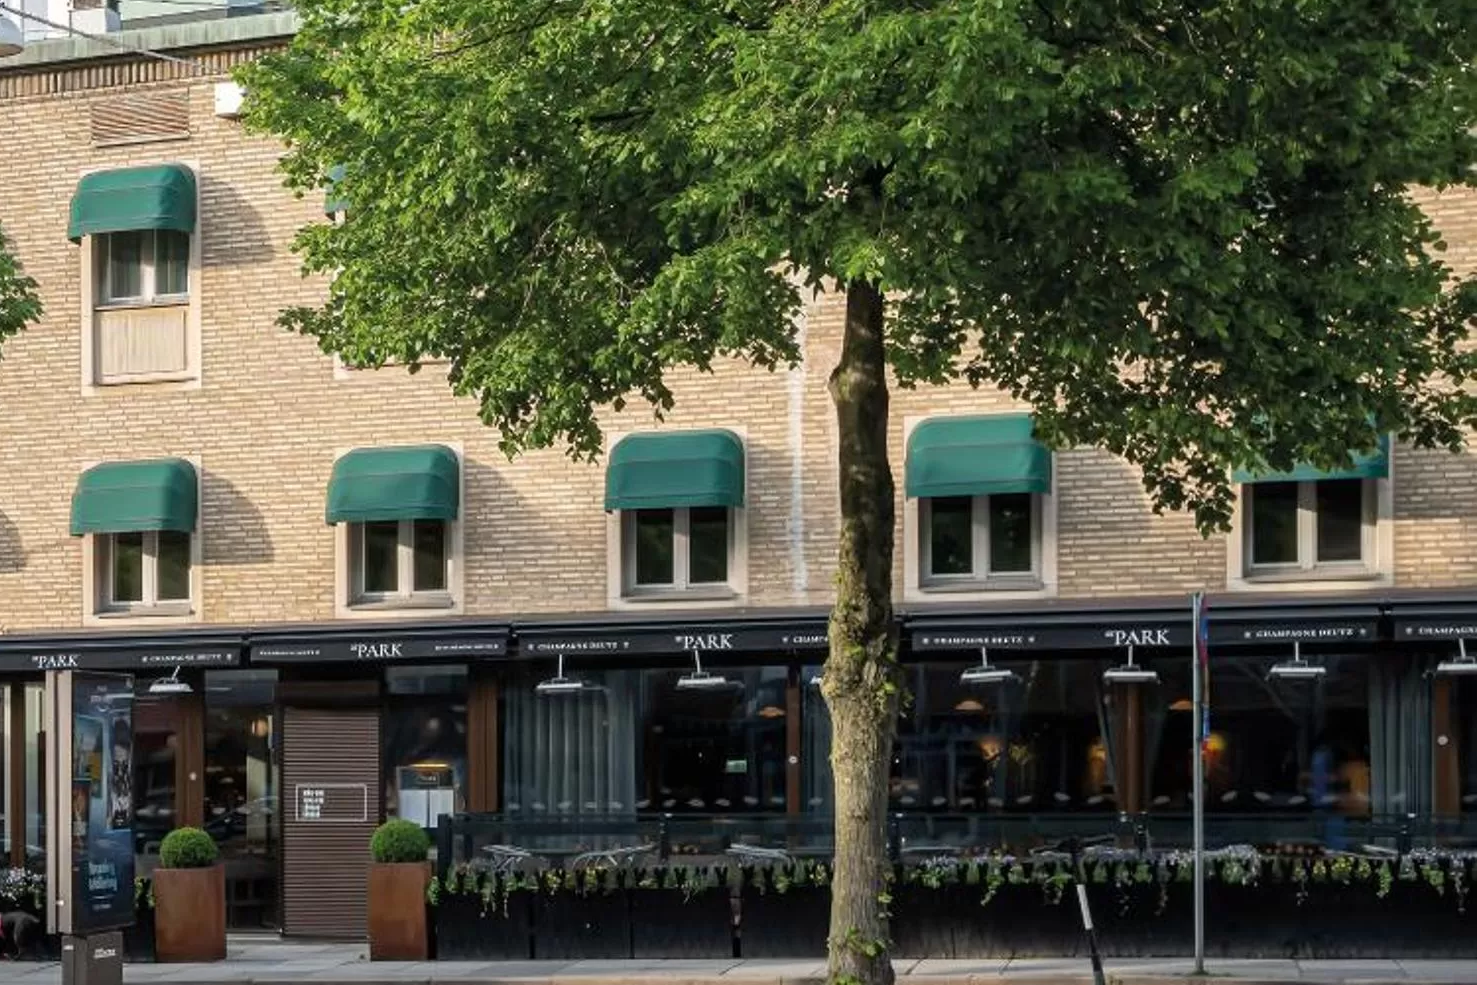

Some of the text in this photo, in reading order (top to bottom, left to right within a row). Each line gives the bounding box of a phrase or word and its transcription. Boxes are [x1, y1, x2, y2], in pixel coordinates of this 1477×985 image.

[683, 633, 734, 650] PARK
[1114, 629, 1171, 646] PARK
[357, 643, 403, 658] PARK
[38, 653, 79, 669] PARK
